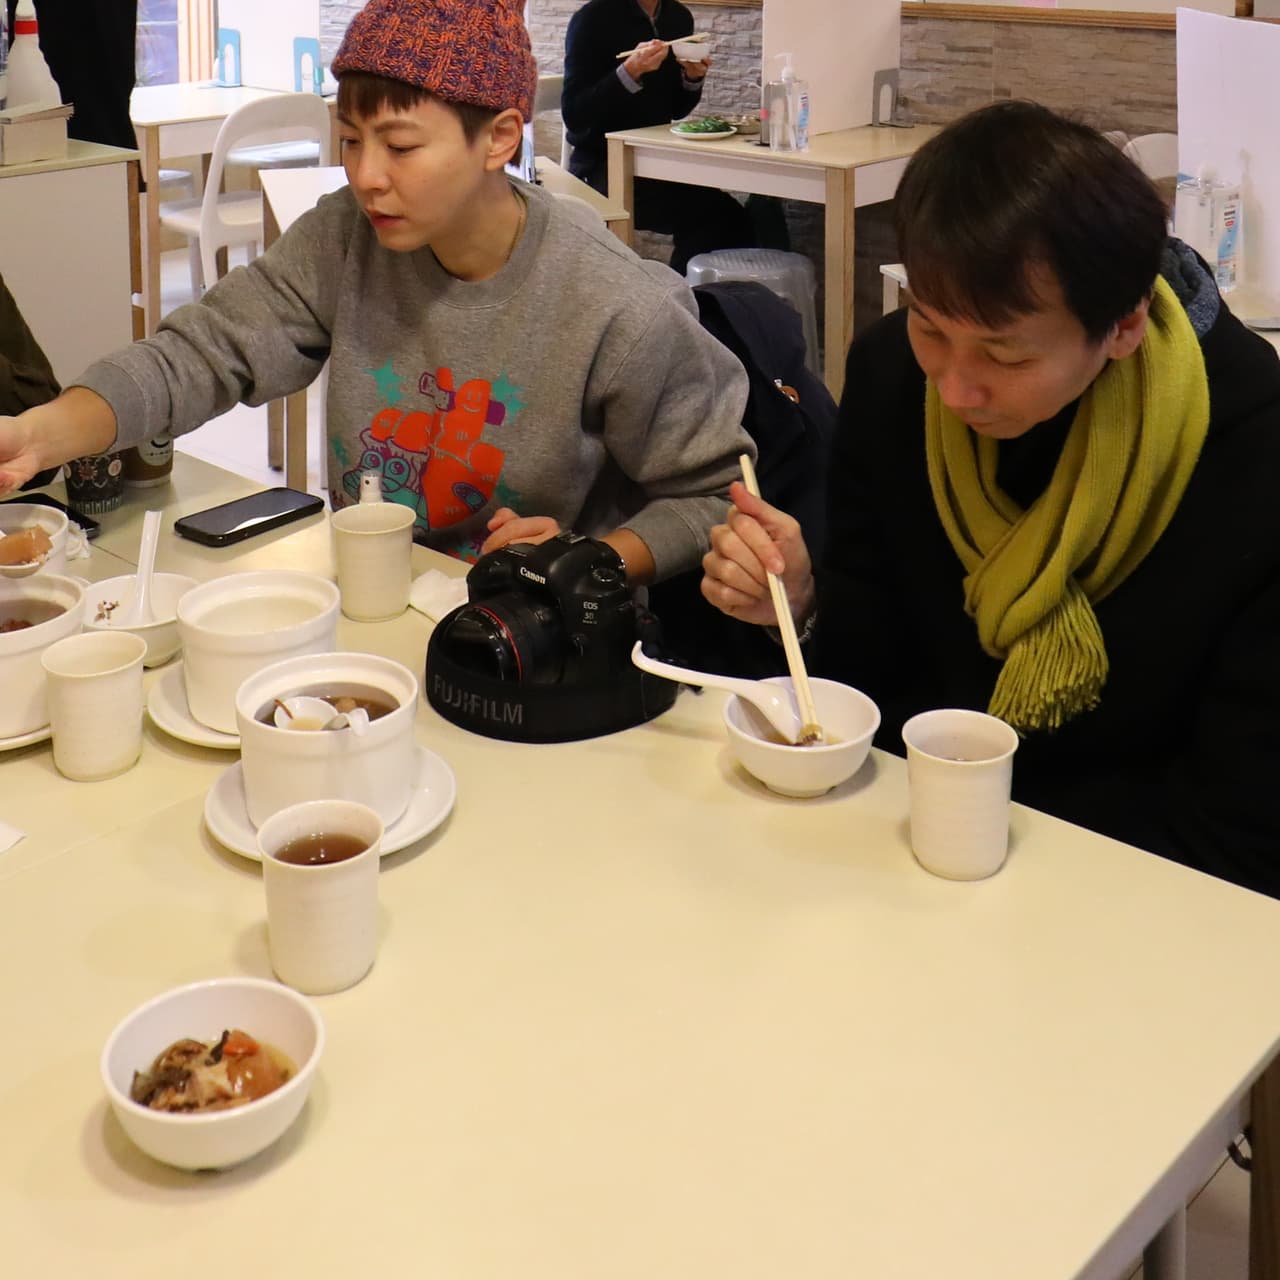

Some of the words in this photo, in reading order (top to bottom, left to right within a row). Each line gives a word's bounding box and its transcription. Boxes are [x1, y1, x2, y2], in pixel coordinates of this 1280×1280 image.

[519, 566, 546, 585] Canon
[583, 601, 599, 611] EOS
[433, 674, 524, 726] FUJIFILM
